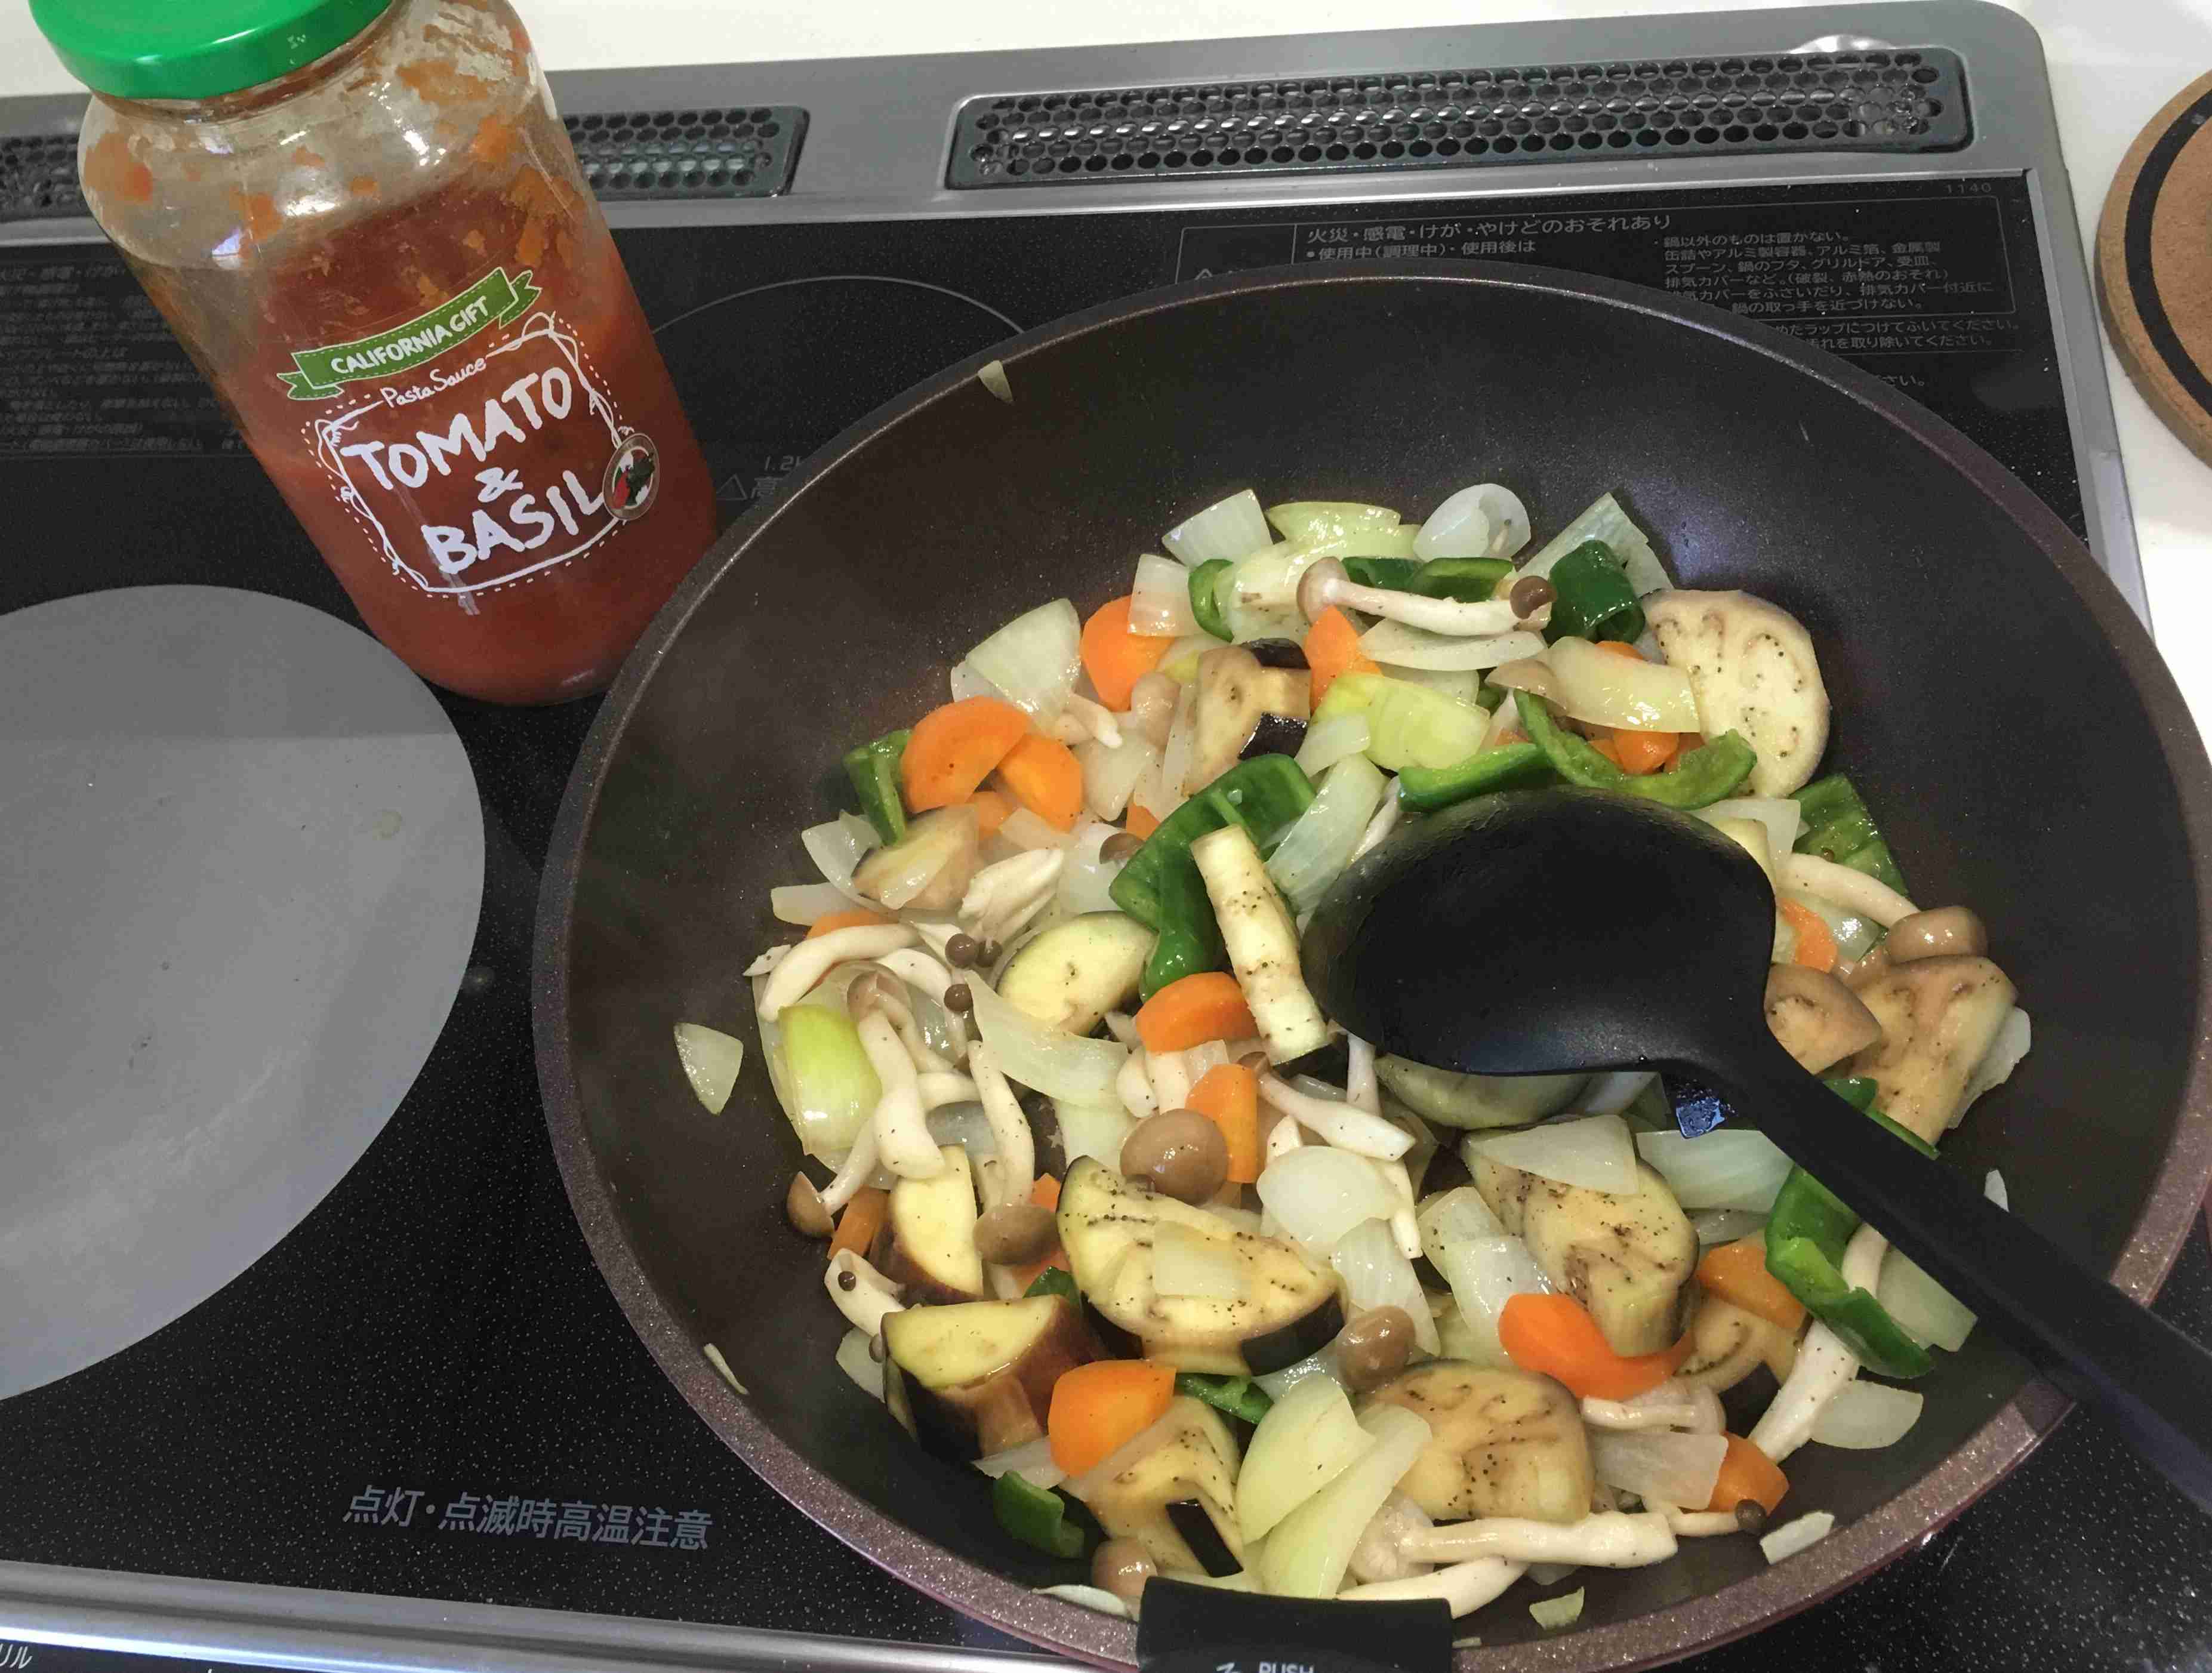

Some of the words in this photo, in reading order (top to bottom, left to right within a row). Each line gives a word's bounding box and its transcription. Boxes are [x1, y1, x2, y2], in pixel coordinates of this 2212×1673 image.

[1944, 181, 1992, 195] 1140
[330, 324, 453, 375] CALIFORNIA
[449, 296, 489, 334] GIFT
[380, 387, 435, 408] Pasta
[429, 358, 487, 394] Sauce
[340, 367, 572, 490] TOMATO
[474, 467, 524, 503] &
[420, 470, 605, 574] BASIL
[343, 1484, 714, 1551] 点灯・点滅時高温注意
